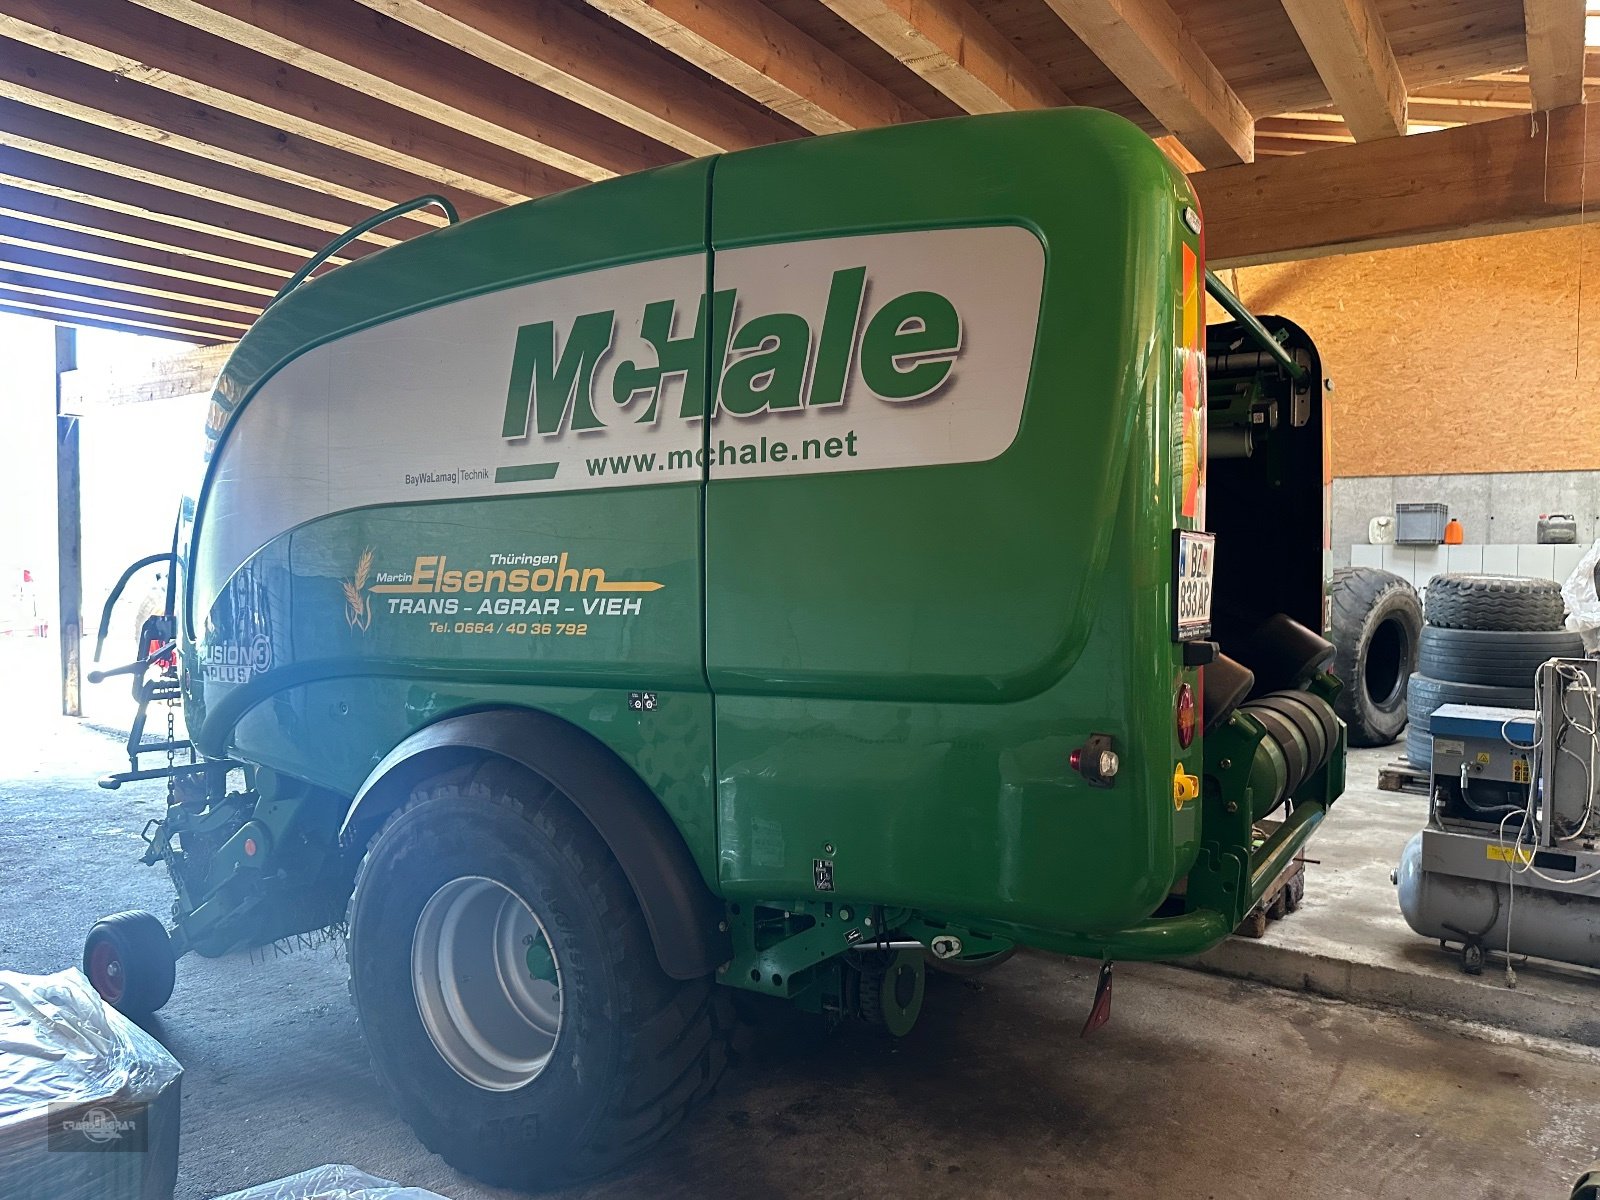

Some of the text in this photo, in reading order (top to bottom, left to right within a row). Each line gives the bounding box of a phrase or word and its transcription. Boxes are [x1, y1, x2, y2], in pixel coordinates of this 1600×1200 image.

[501, 266, 963, 440] McHale
[585, 430, 858, 476] www.mchale.net
[376, 552, 606, 593] Martin Elsensohn
[490, 553, 559, 566] Thüringen
[1191, 542, 1203, 577] BZ
[388, 599, 459, 615] TRANS
[476, 599, 559, 615] AGRAR
[582, 598, 643, 616] VIEH
[429, 622, 451, 634] Tel.
[454, 623, 494, 634] 0664
[505, 623, 527, 635] 40
[530, 624, 552, 635] 36
[555, 624, 588, 636] 792
[210, 667, 247, 682] PLUS
